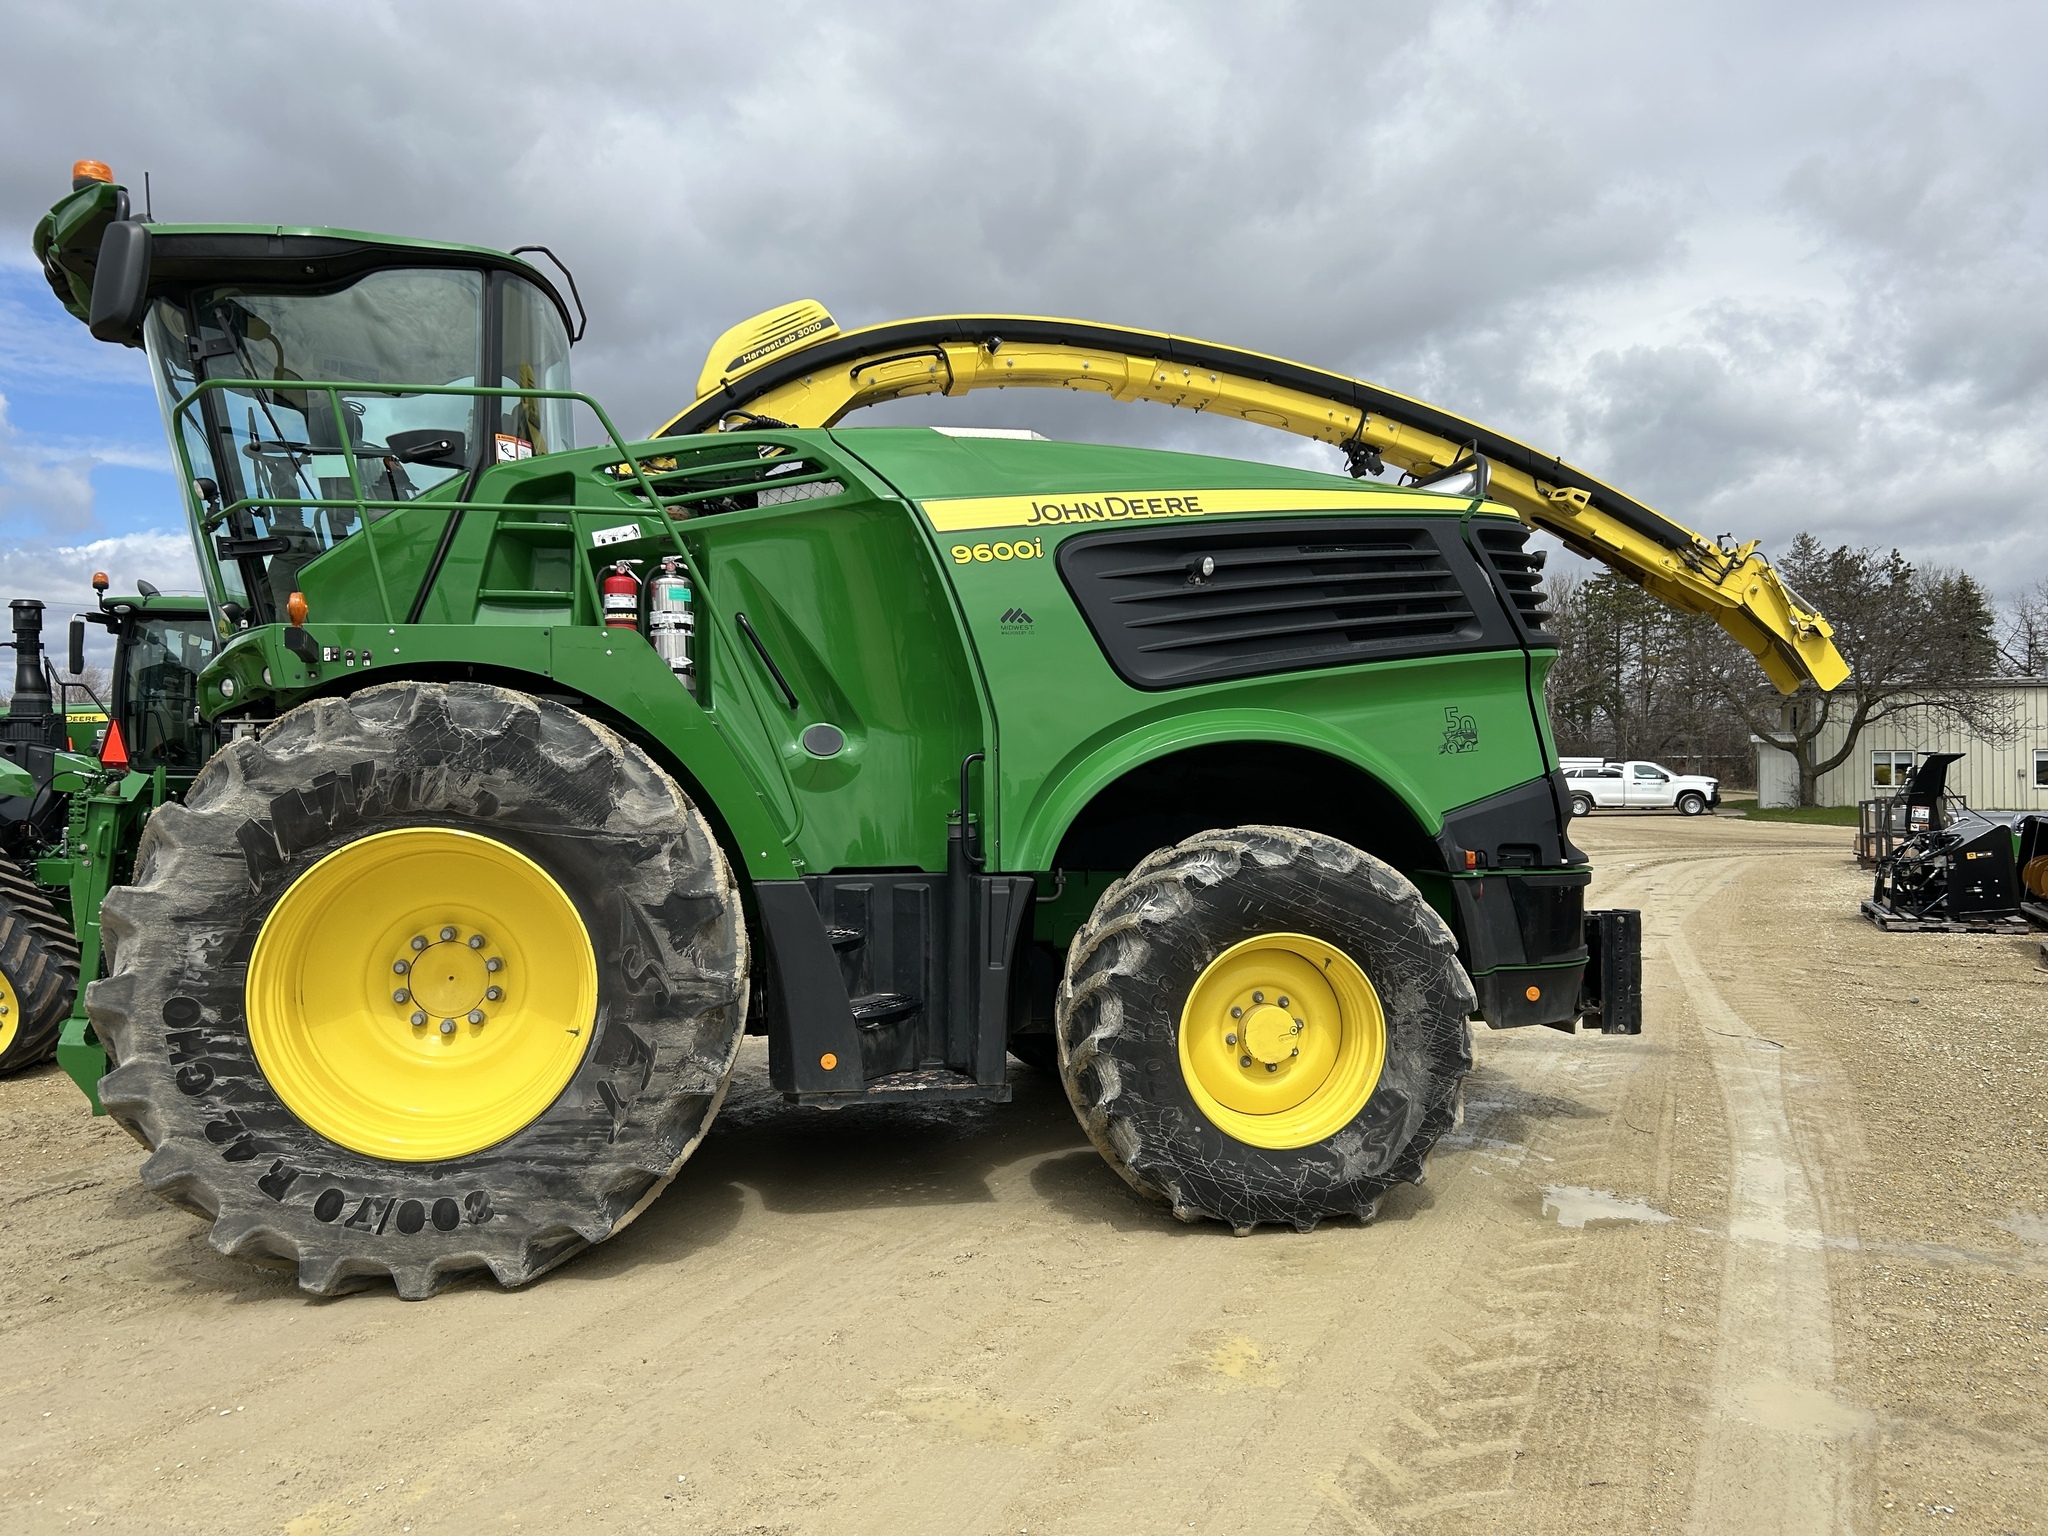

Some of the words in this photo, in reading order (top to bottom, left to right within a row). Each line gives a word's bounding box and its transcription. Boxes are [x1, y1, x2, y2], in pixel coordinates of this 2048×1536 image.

[743, 334, 796, 363] HarvestLab
[797, 322, 821, 337] 3000
[1028, 502, 1104, 523] JOHN
[1105, 496, 1203, 518] DEERE
[950, 537, 1044, 564] 9600i
[313, 1188, 495, 1236] 800/70
